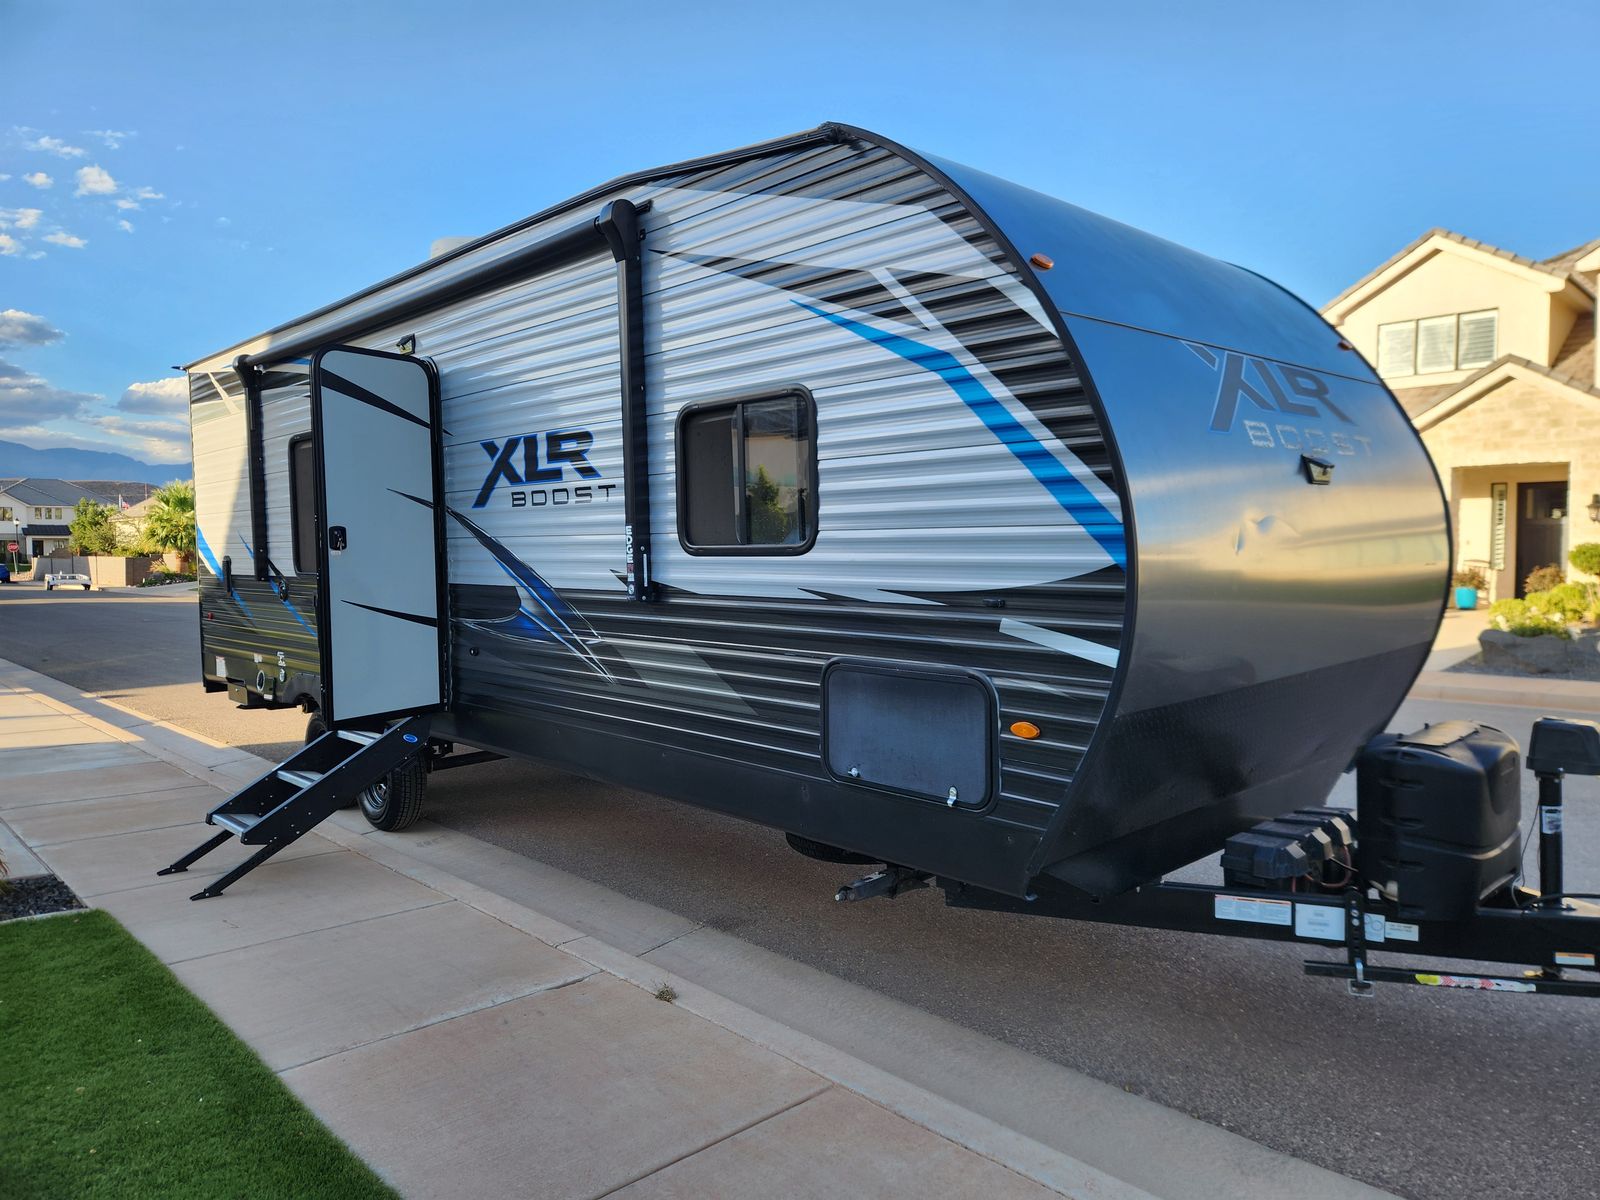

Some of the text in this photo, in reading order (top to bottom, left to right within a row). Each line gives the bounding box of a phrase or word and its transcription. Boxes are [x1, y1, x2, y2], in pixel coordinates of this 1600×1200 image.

[1179, 340, 1358, 433] XLR
[1243, 420, 1372, 456] BOOST
[472, 427, 602, 508] XLR
[511, 484, 616, 508] BOOST
[625, 525, 634, 564] EDGE
